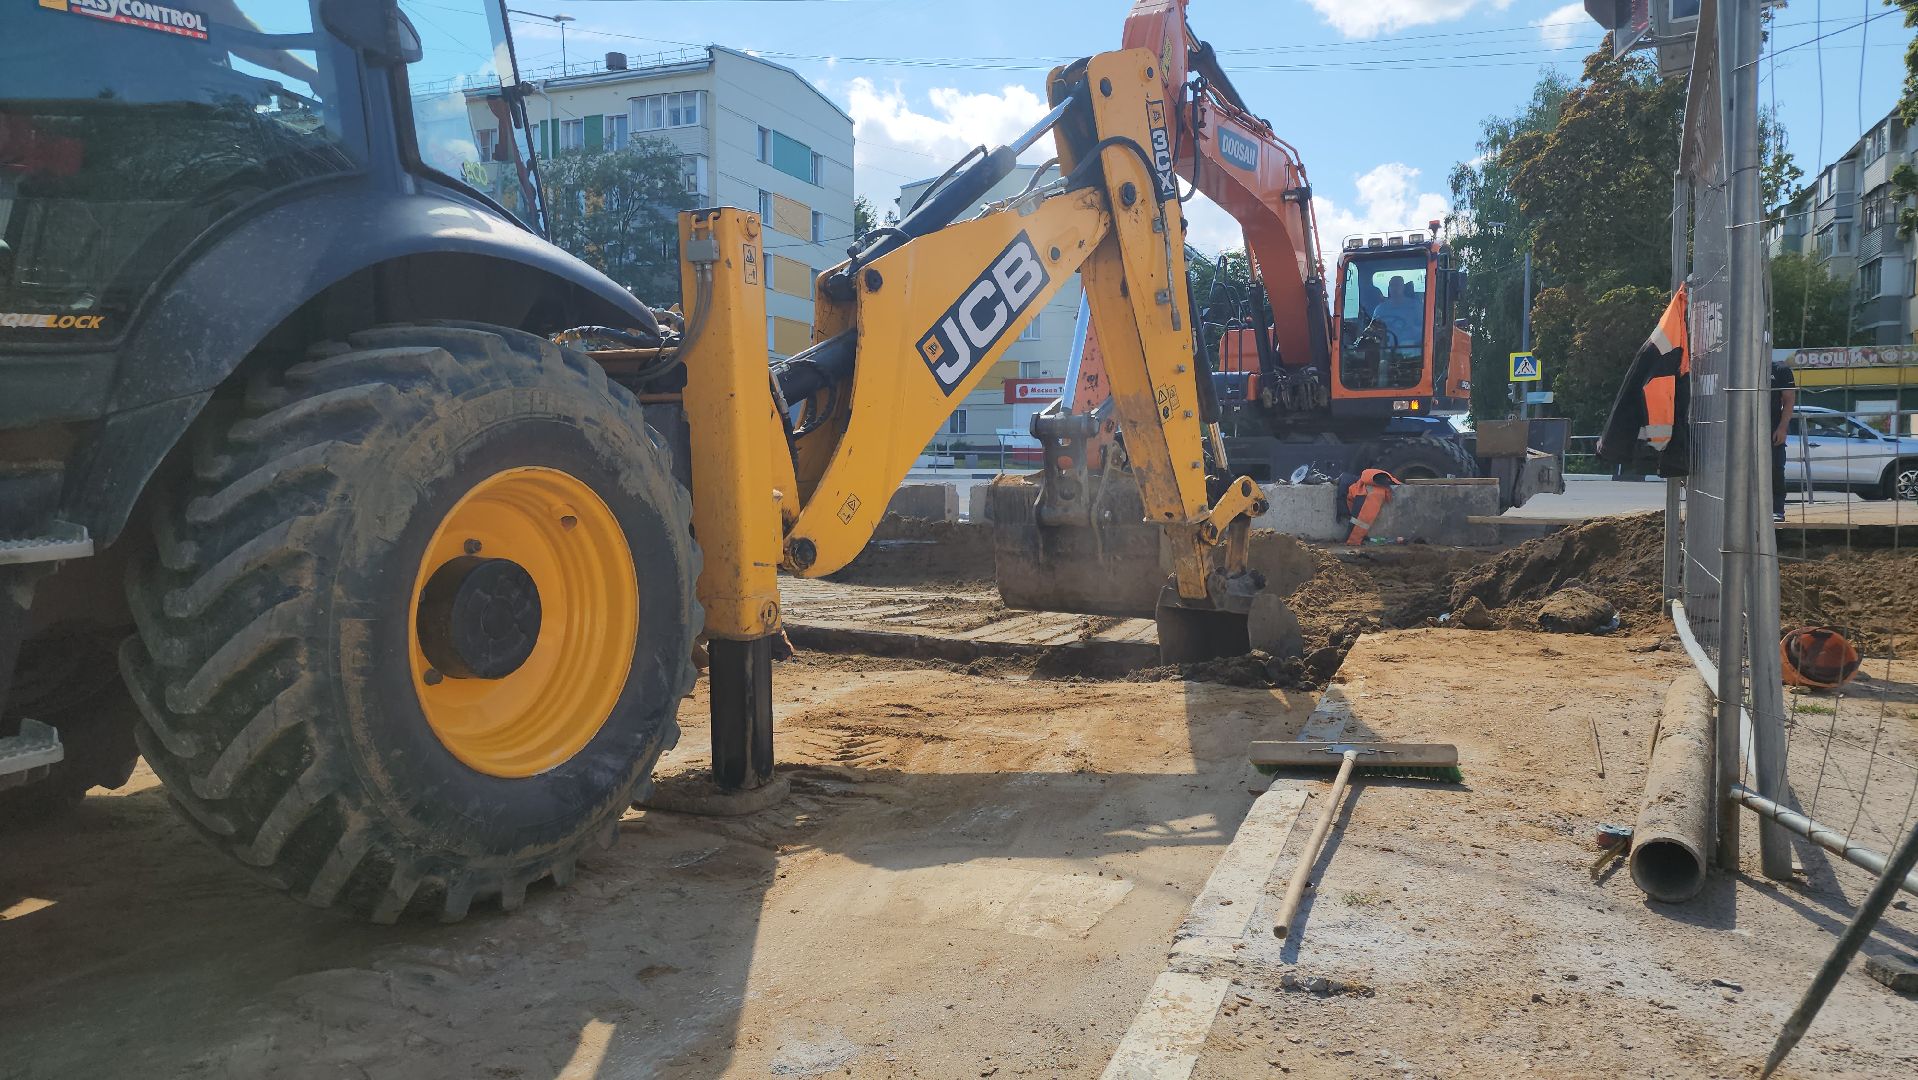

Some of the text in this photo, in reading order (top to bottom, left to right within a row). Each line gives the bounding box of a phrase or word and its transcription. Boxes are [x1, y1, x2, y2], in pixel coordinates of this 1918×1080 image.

[1152, 129, 1174, 192] 3CX
[1222, 134, 1257, 166] DOOSAN
[0, 313, 105, 328] QUELOCK
[936, 241, 1043, 385] JCB
[1794, 351, 1863, 365] ОВОЩИ
